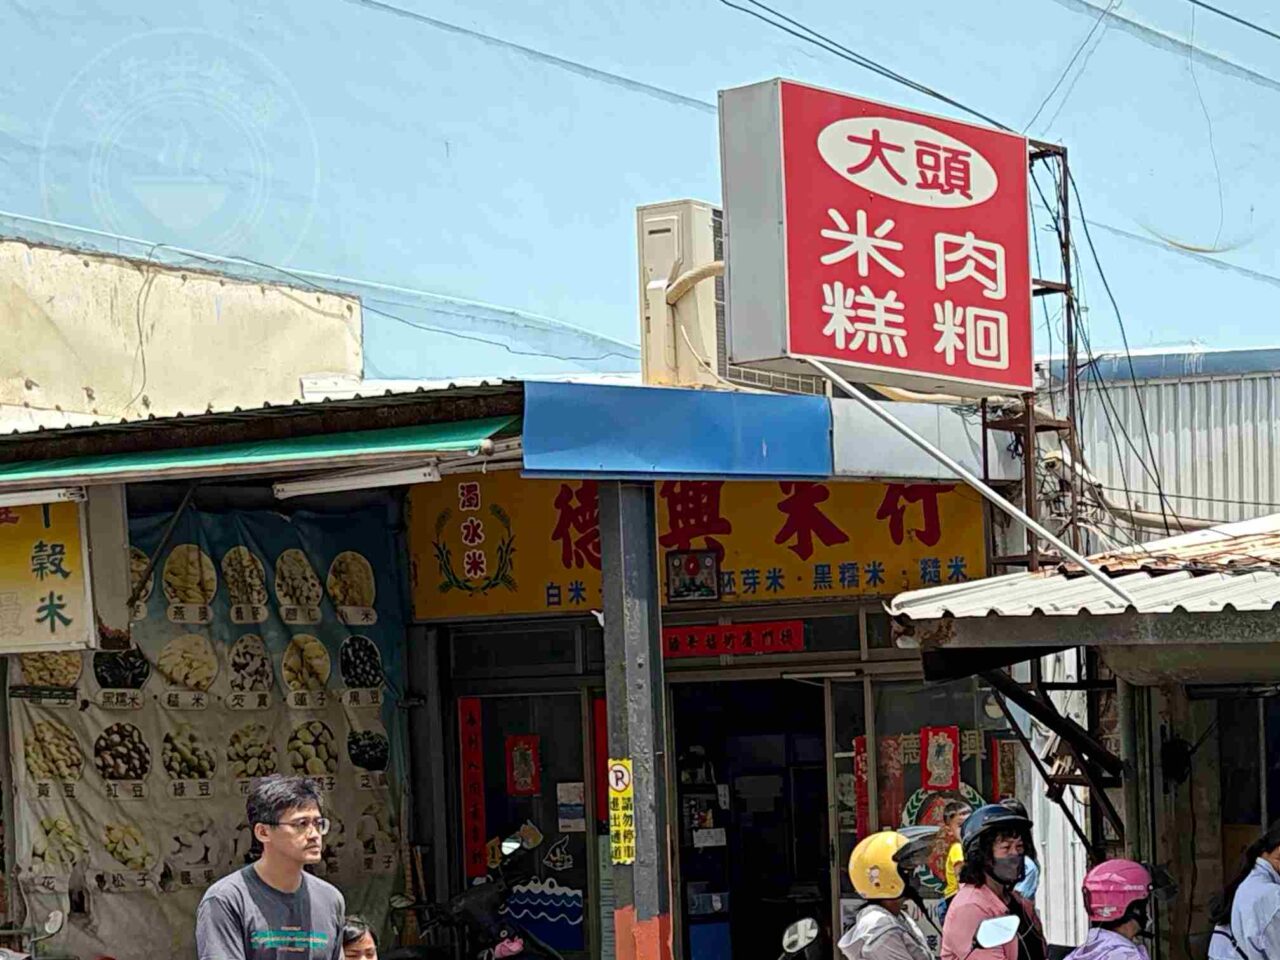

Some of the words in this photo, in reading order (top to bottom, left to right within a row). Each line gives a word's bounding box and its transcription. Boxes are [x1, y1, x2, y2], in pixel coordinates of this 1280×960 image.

[846, 129, 974, 200] 大頭
[819, 208, 908, 358] 米糕
[32, 503, 73, 633] 穀米
[546, 580, 587, 606] 白米
[813, 561, 886, 590] 黑糯米
[919, 555, 968, 584] 糙米
[621, 797, 635, 859] 請勿停車
